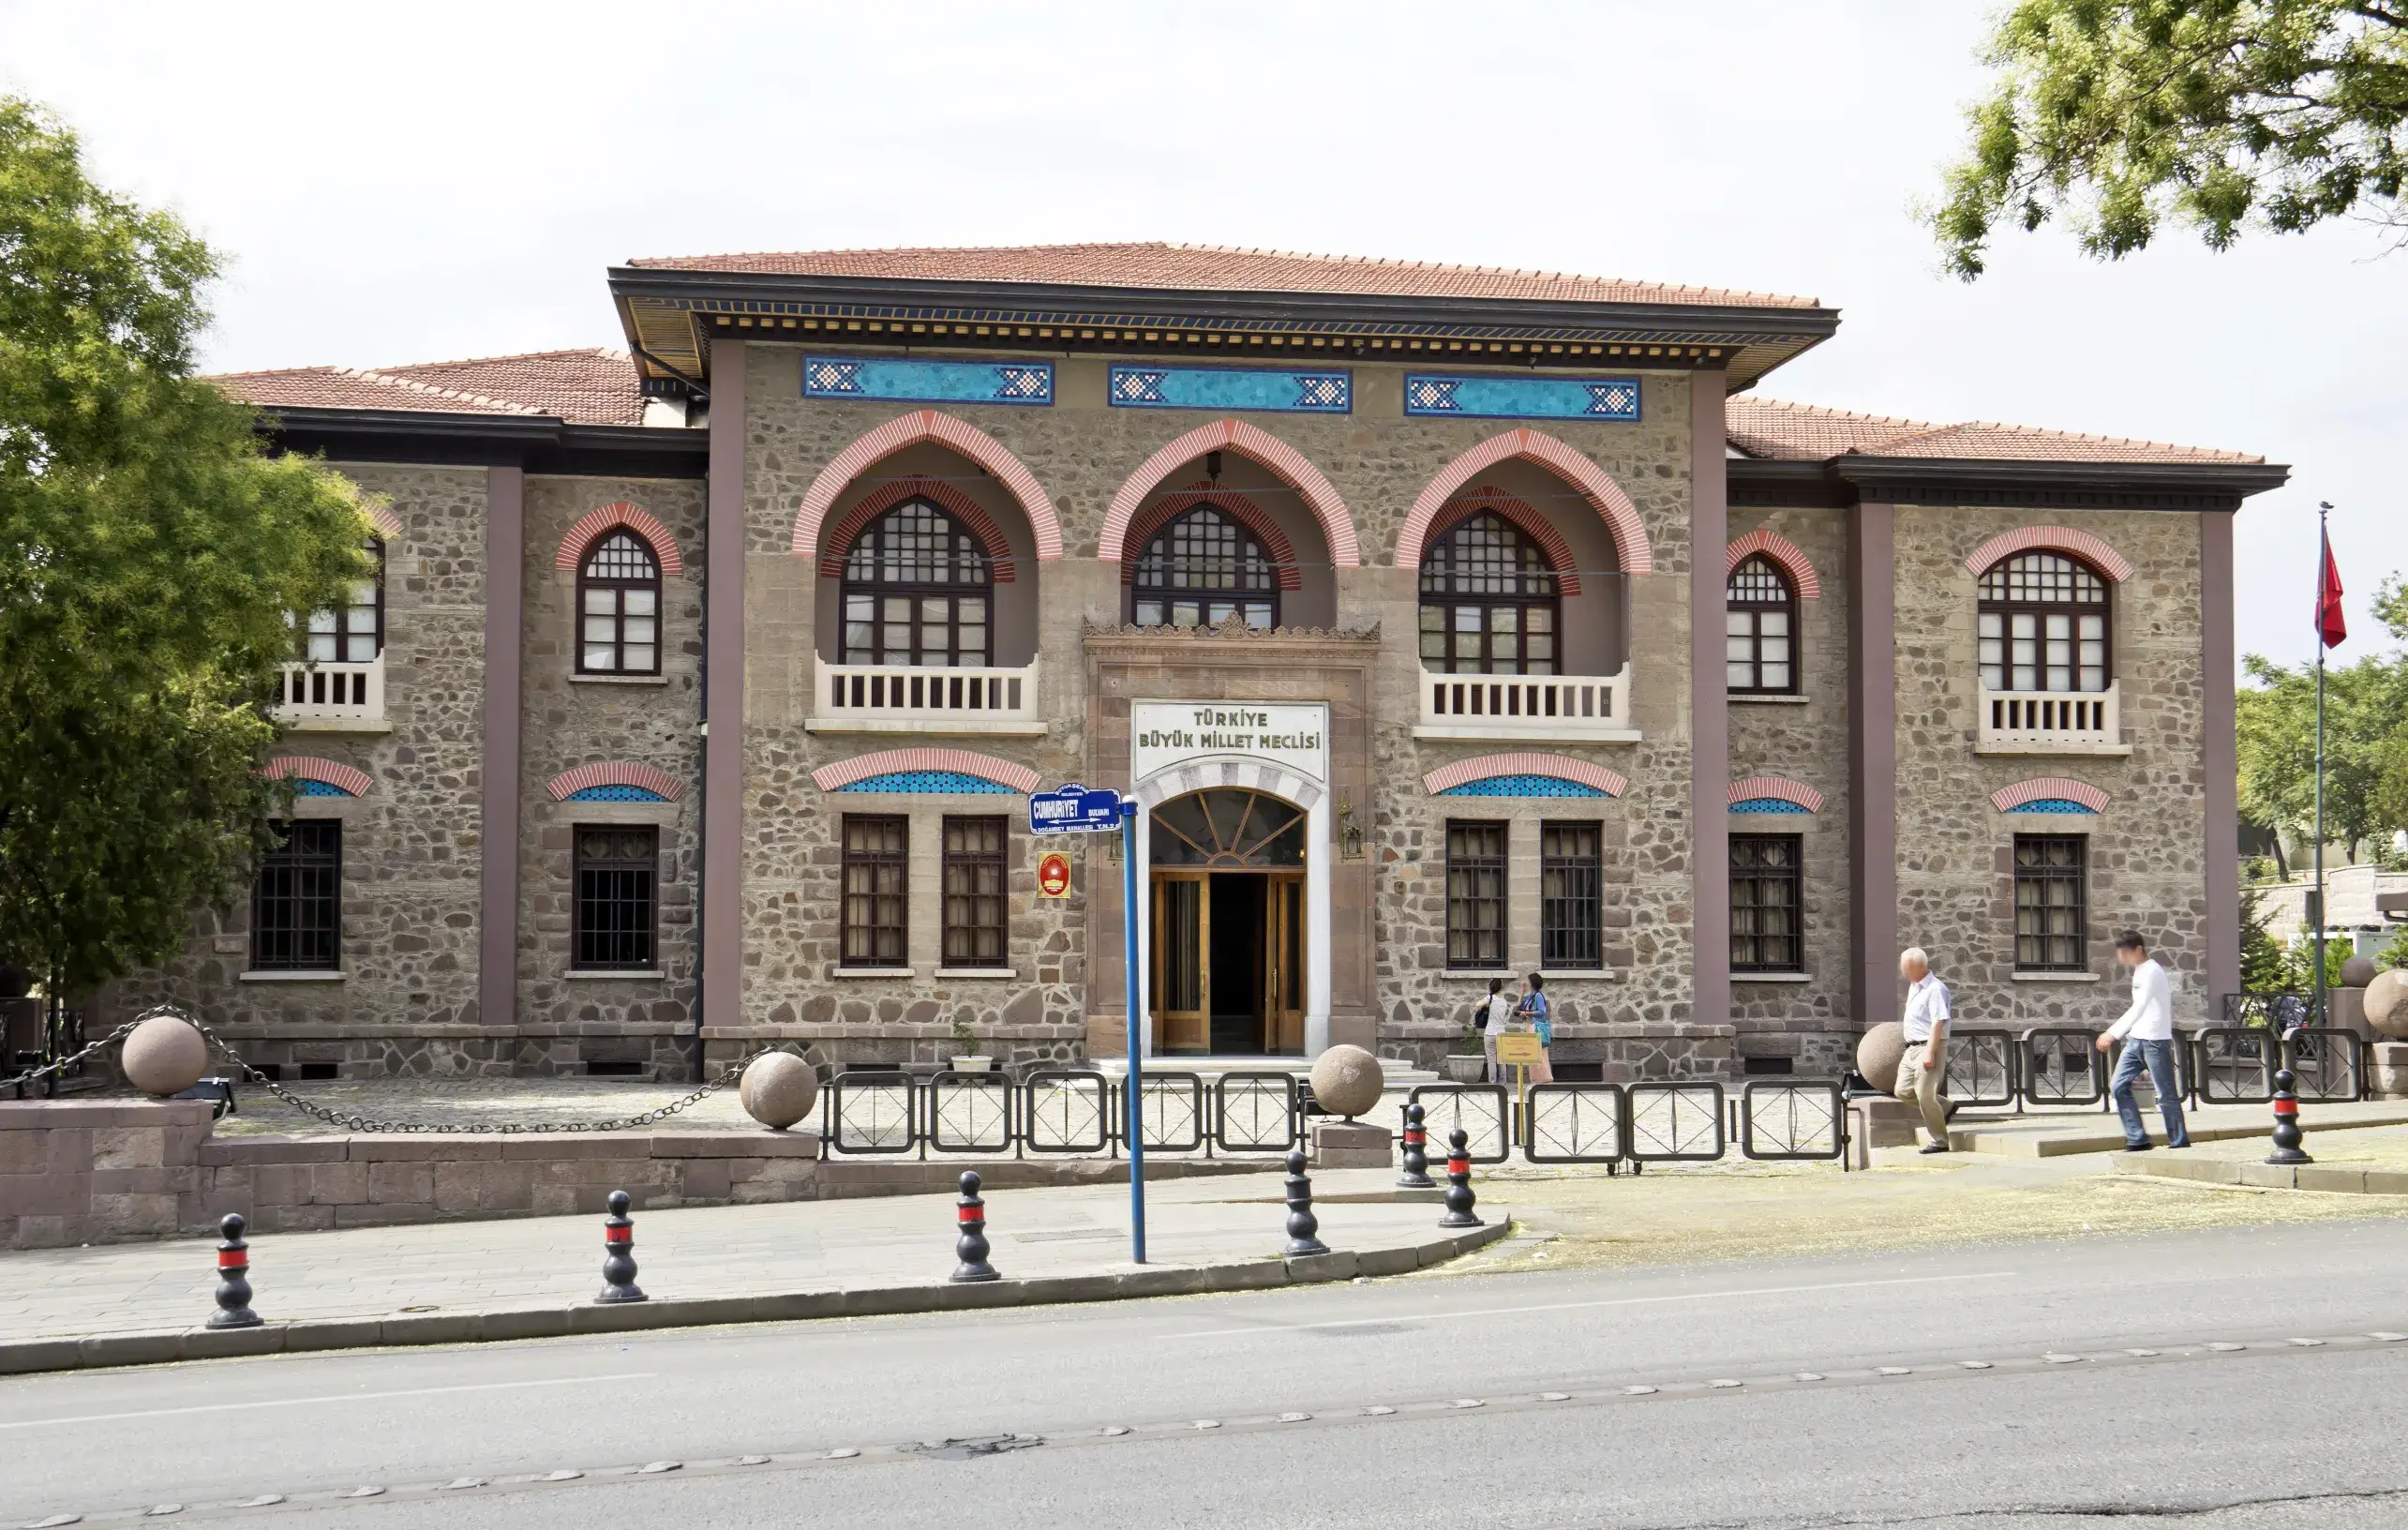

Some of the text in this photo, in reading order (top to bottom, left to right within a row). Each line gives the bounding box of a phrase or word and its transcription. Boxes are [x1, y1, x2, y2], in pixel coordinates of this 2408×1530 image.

[1193, 708, 1268, 727] TÜRKİYE
[1139, 729, 1321, 750] BÜYÜK MİLLET MECLİSİ
[1088, 808, 1110, 817] BULVARI
